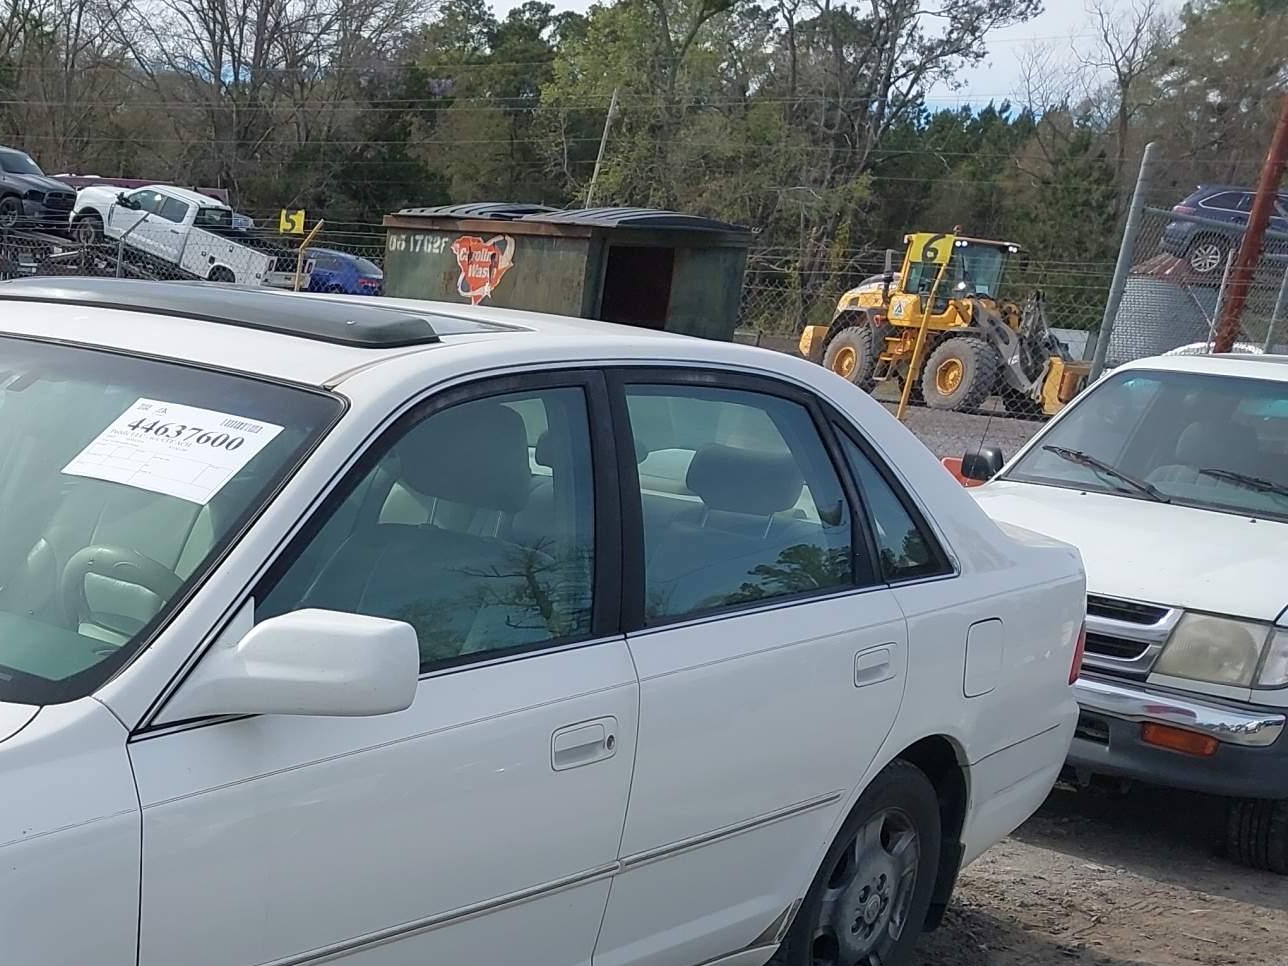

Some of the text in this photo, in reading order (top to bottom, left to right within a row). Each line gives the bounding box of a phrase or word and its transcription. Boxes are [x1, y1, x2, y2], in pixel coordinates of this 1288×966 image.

[282, 209, 298, 232] 5
[460, 248, 497, 262] Carolin
[922, 233, 946, 262] 6
[128, 417, 245, 451] 44637600
